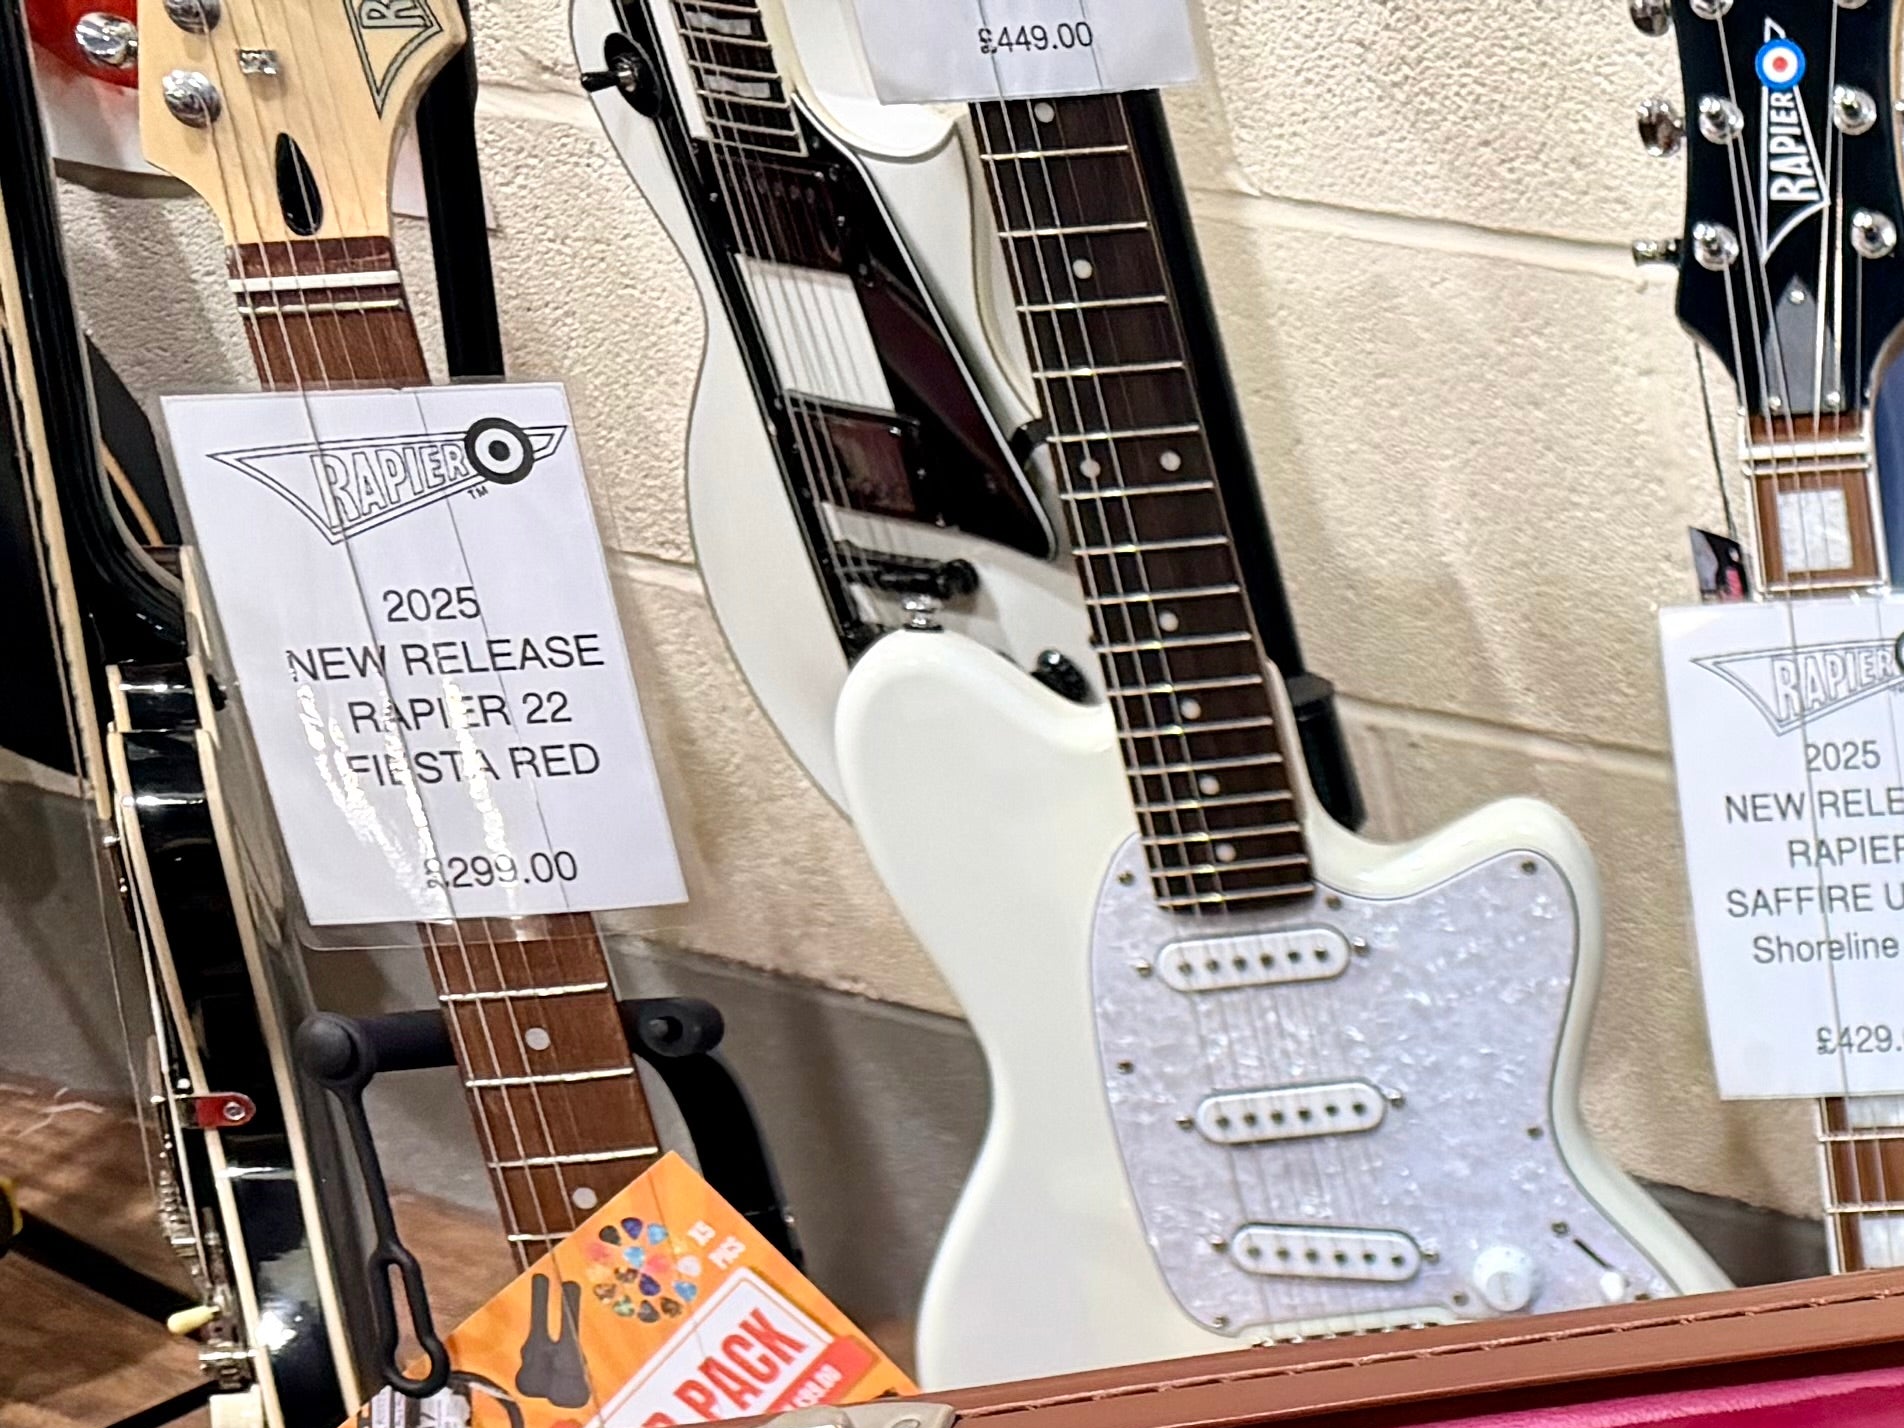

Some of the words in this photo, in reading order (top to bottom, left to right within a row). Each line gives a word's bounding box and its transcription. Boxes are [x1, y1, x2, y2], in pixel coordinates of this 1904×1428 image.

[978, 22, 1093, 54] £449.00
[1769, 91, 1820, 201] RAPIER
[311, 443, 469, 526] RAPIER
[383, 586, 481, 622] 2025
[286, 645, 387, 682] NEW
[401, 634, 605, 676] RELEASE
[1771, 651, 1901, 722] RAPIER
[348, 695, 511, 734] RAPIER
[522, 691, 572, 724] 22
[508, 743, 600, 779] RED
[1806, 740, 1881, 772] 2025
[1725, 791, 1806, 823] NEW
[1727, 884, 1874, 919] SAFFIRE
[1752, 929, 1899, 964] Shoreline
[674, 1307, 808, 1421] PACK
